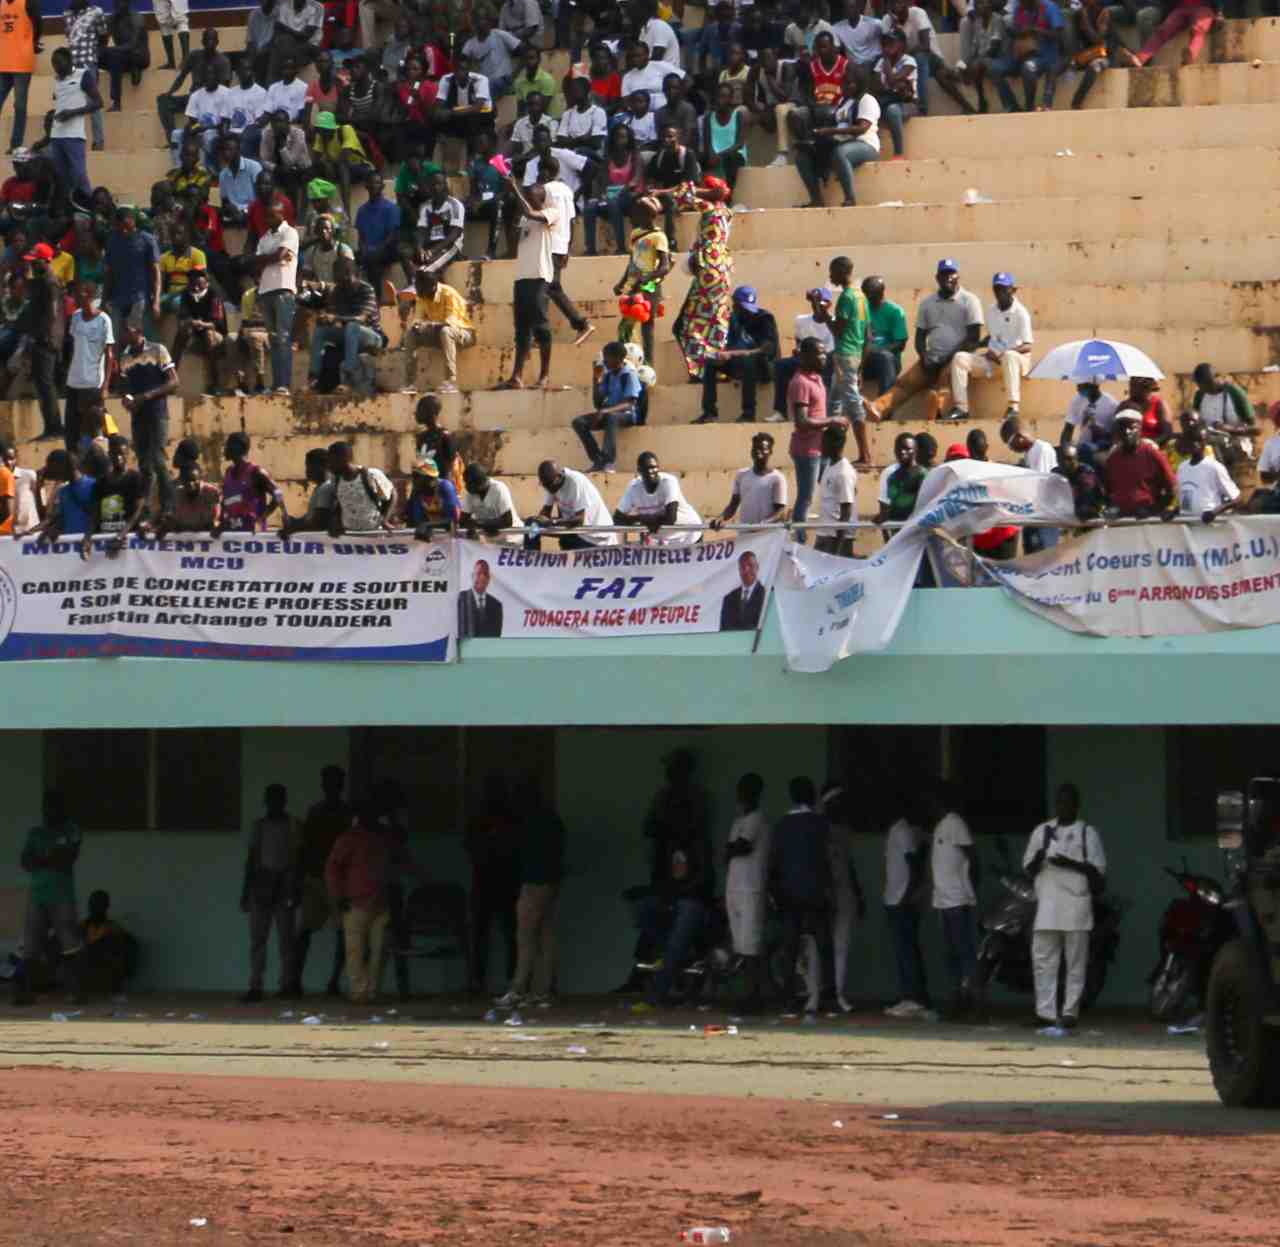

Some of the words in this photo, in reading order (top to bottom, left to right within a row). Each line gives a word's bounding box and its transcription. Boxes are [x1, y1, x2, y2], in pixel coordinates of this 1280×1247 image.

[696, 541, 735, 562] 2020
[181, 556, 245, 570] MCU
[21, 577, 107, 595] CADRES
[113, 576, 139, 590] DE
[144, 577, 315, 594] CONCERTATION
[320, 581, 348, 594] DE
[353, 580, 449, 594] SOUTIEN
[573, 575, 655, 600] FAT
[61, 597, 75, 610] A
[80, 593, 122, 608] SON
[128, 594, 262, 610] EXCELLENCE
[264, 597, 409, 611] PROFESSEUR
[67, 610, 150, 626] Faustin
[154, 611, 268, 628] Archange
[273, 614, 393, 628] TOUADERA
[592, 608, 625, 627] FACE
[628, 608, 647, 625] AU
[649, 604, 701, 625] PEUPLE
